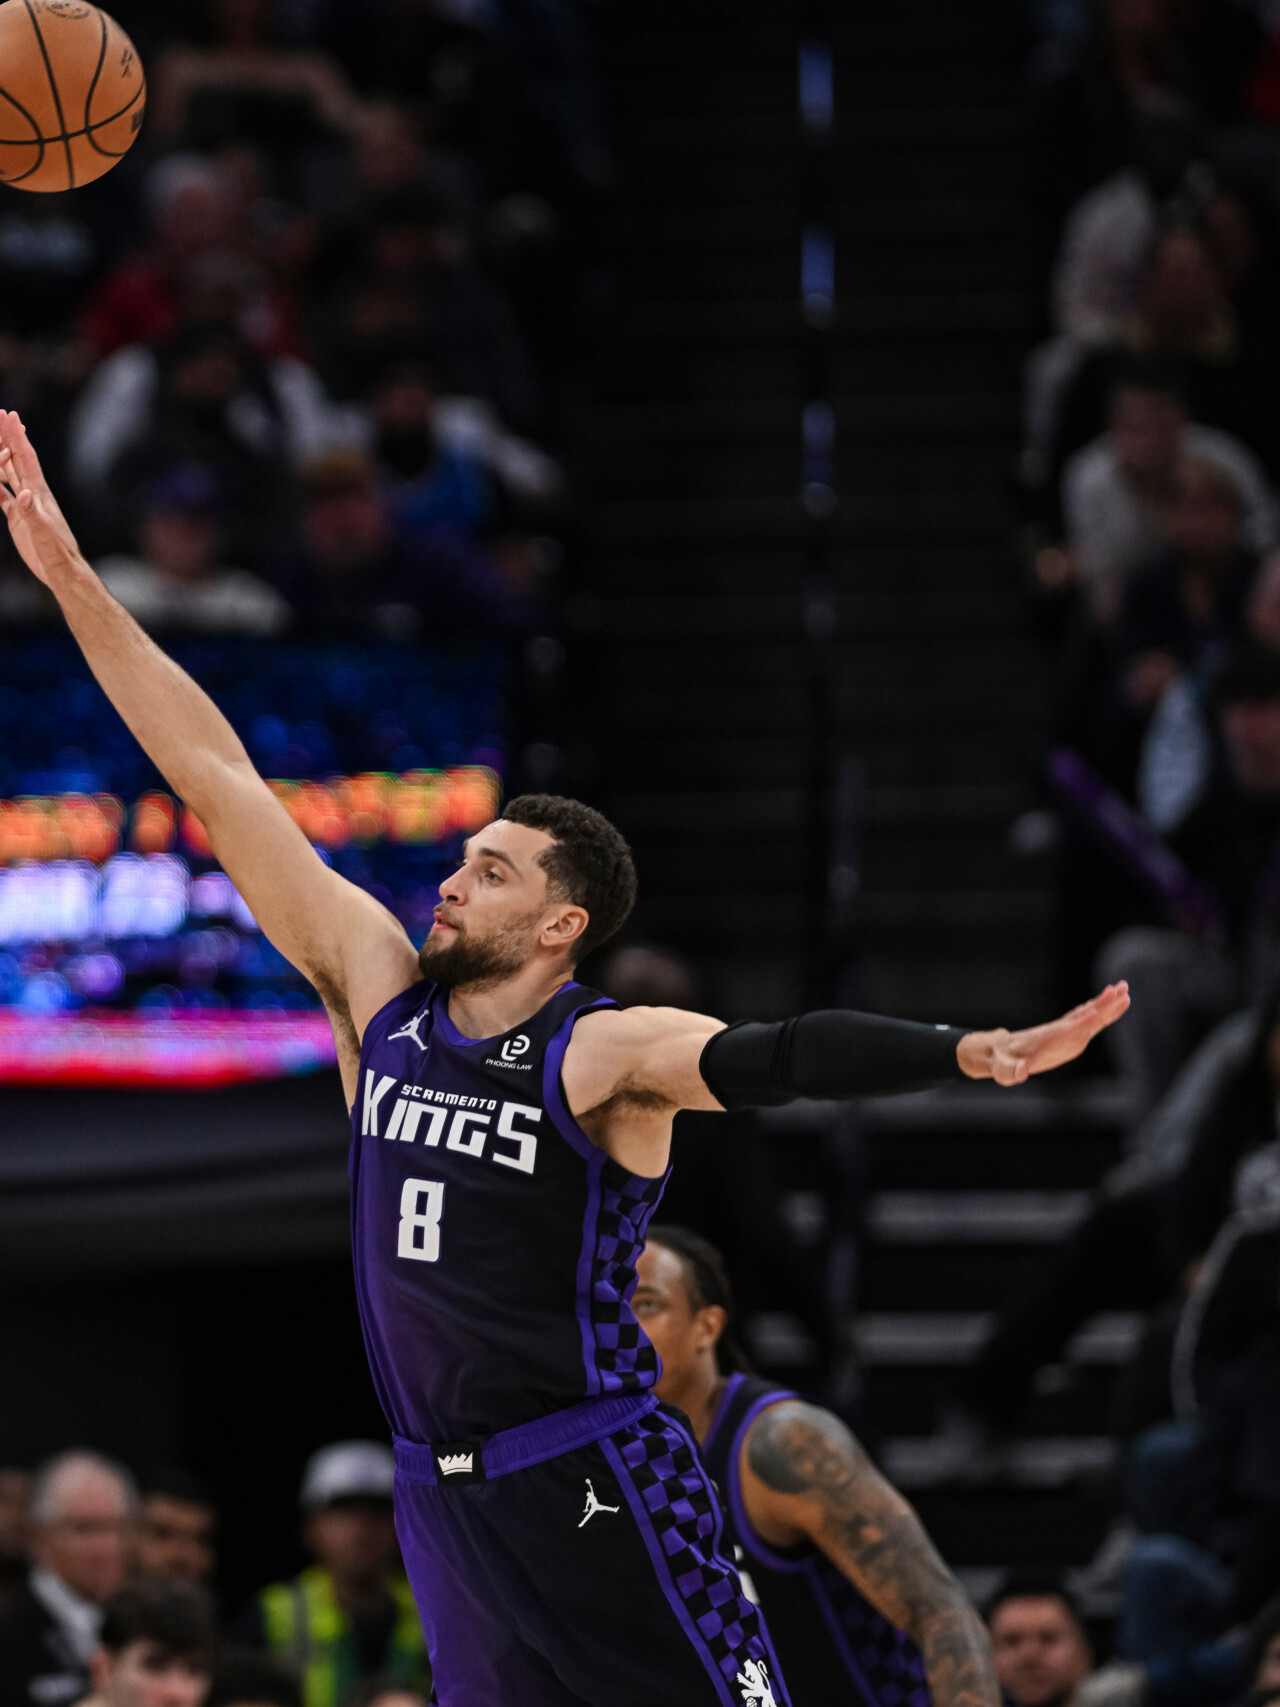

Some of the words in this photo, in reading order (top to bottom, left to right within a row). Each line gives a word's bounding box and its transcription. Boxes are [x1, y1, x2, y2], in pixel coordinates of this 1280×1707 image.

[485, 1058, 517, 1069] PHOONG
[361, 1068, 543, 1175] KINGS
[397, 1177, 446, 1263] 8
